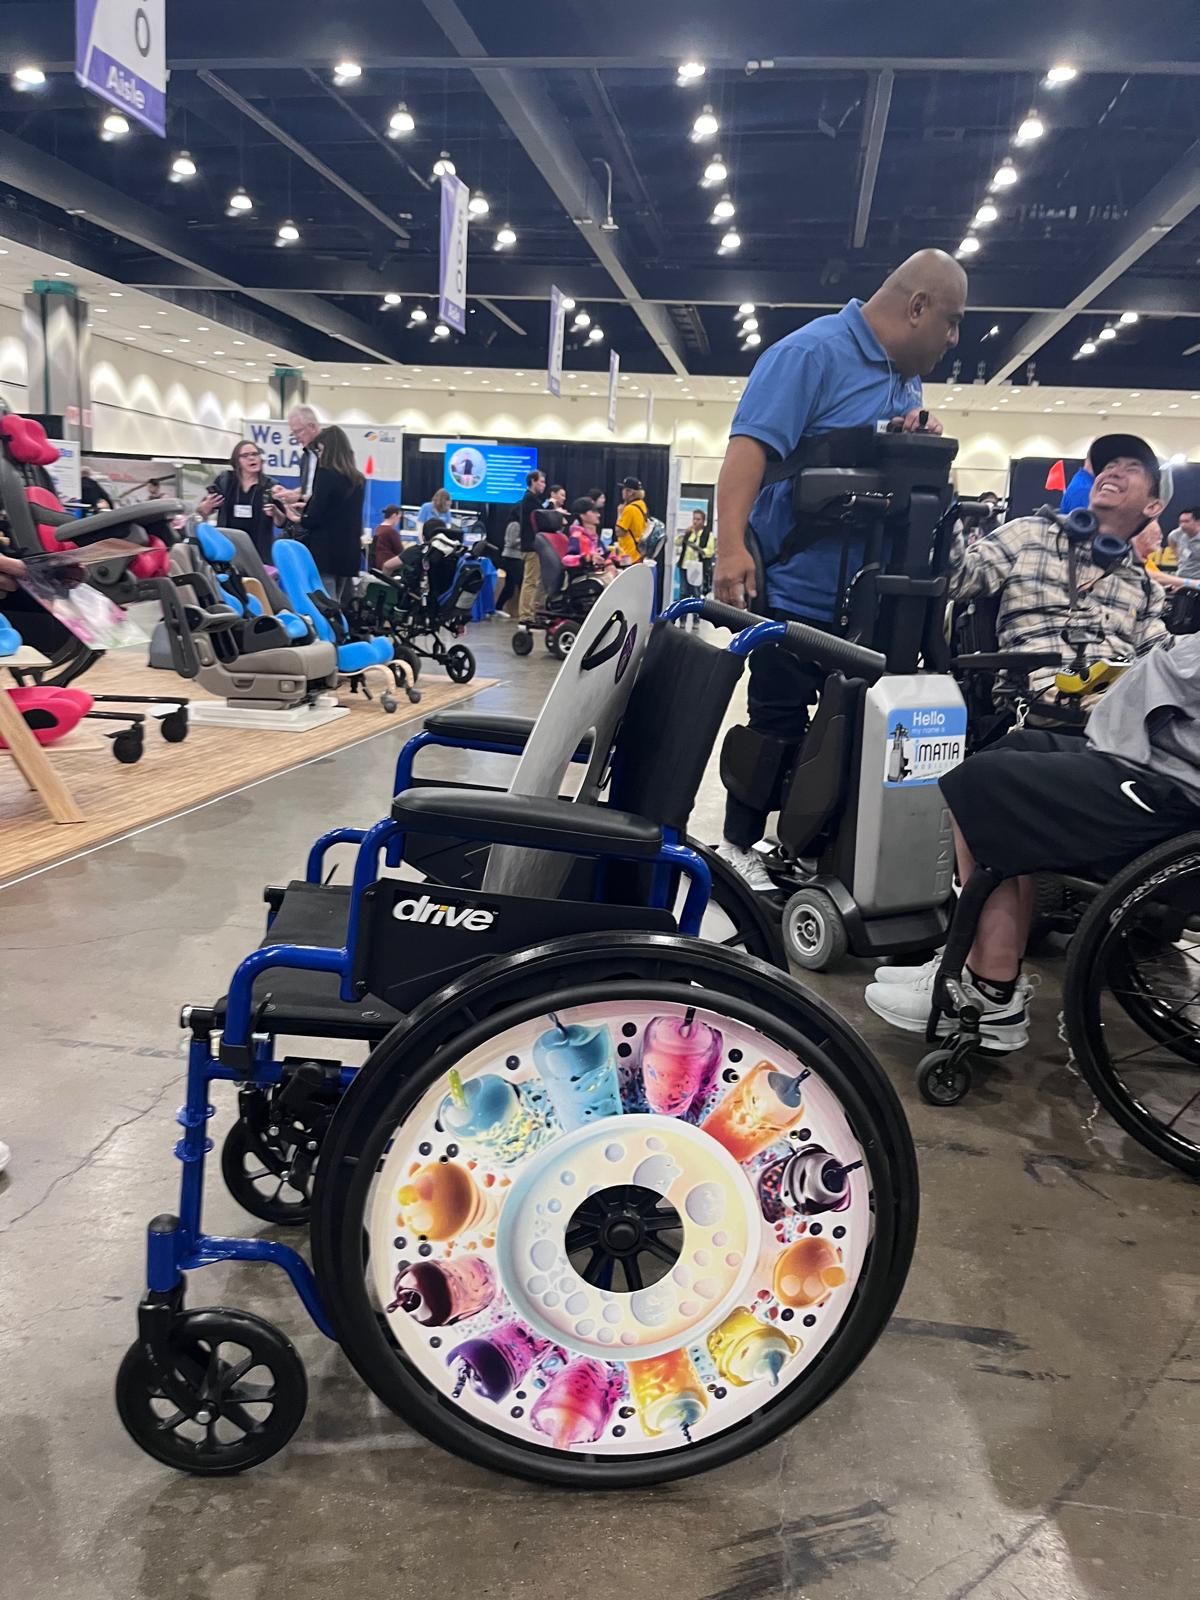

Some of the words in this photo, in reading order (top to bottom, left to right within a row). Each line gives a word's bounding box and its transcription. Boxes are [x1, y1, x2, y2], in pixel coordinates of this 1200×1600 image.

[134, 0, 151, 58] 0
[106, 65, 146, 110] Aisle
[251, 425, 282, 444] We
[912, 711, 946, 726] Hello
[392, 895, 494, 931] drive
